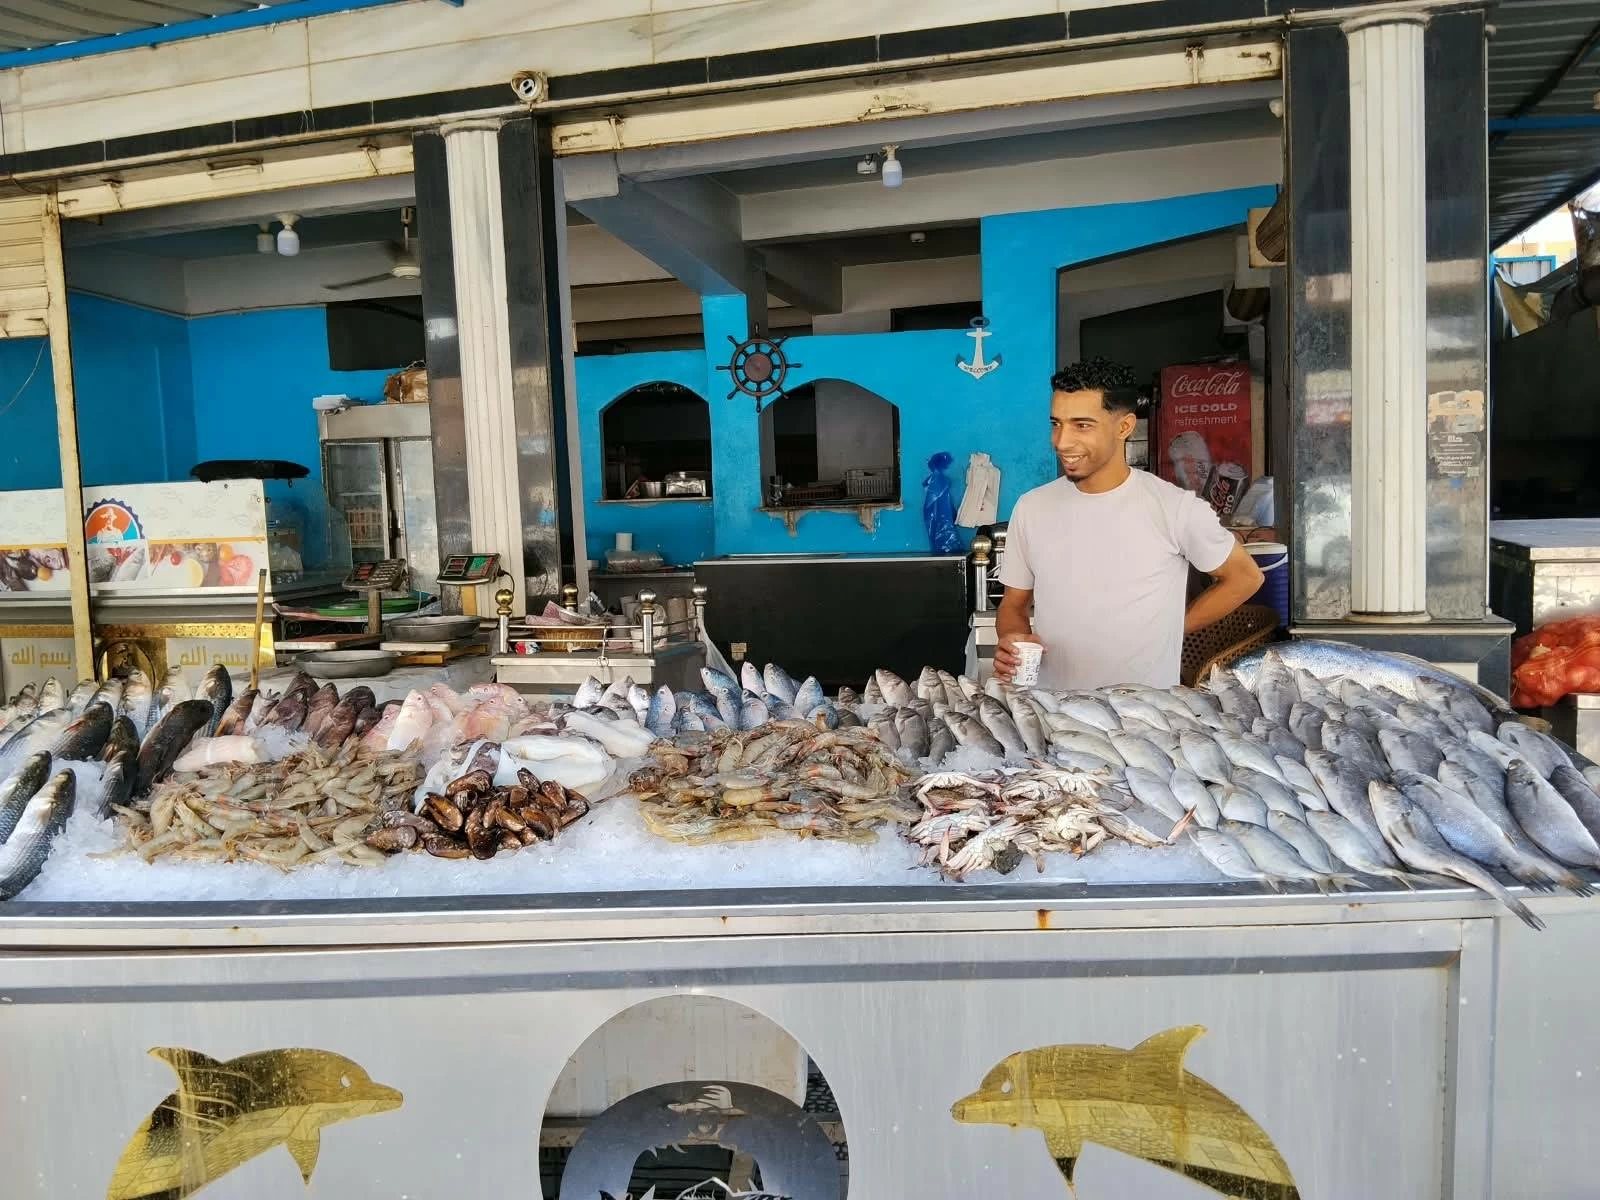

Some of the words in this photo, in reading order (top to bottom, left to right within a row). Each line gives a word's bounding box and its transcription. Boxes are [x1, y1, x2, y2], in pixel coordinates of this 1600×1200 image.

[1175, 404, 1199, 414] ICE
[1201, 402, 1238, 413] COLD
[1175, 415, 1238, 426] refreshment
[11, 646, 35, 665] الله
[39, 651, 71, 669] بسم
[179, 646, 206, 667] الله
[213, 651, 248, 671] بسم
